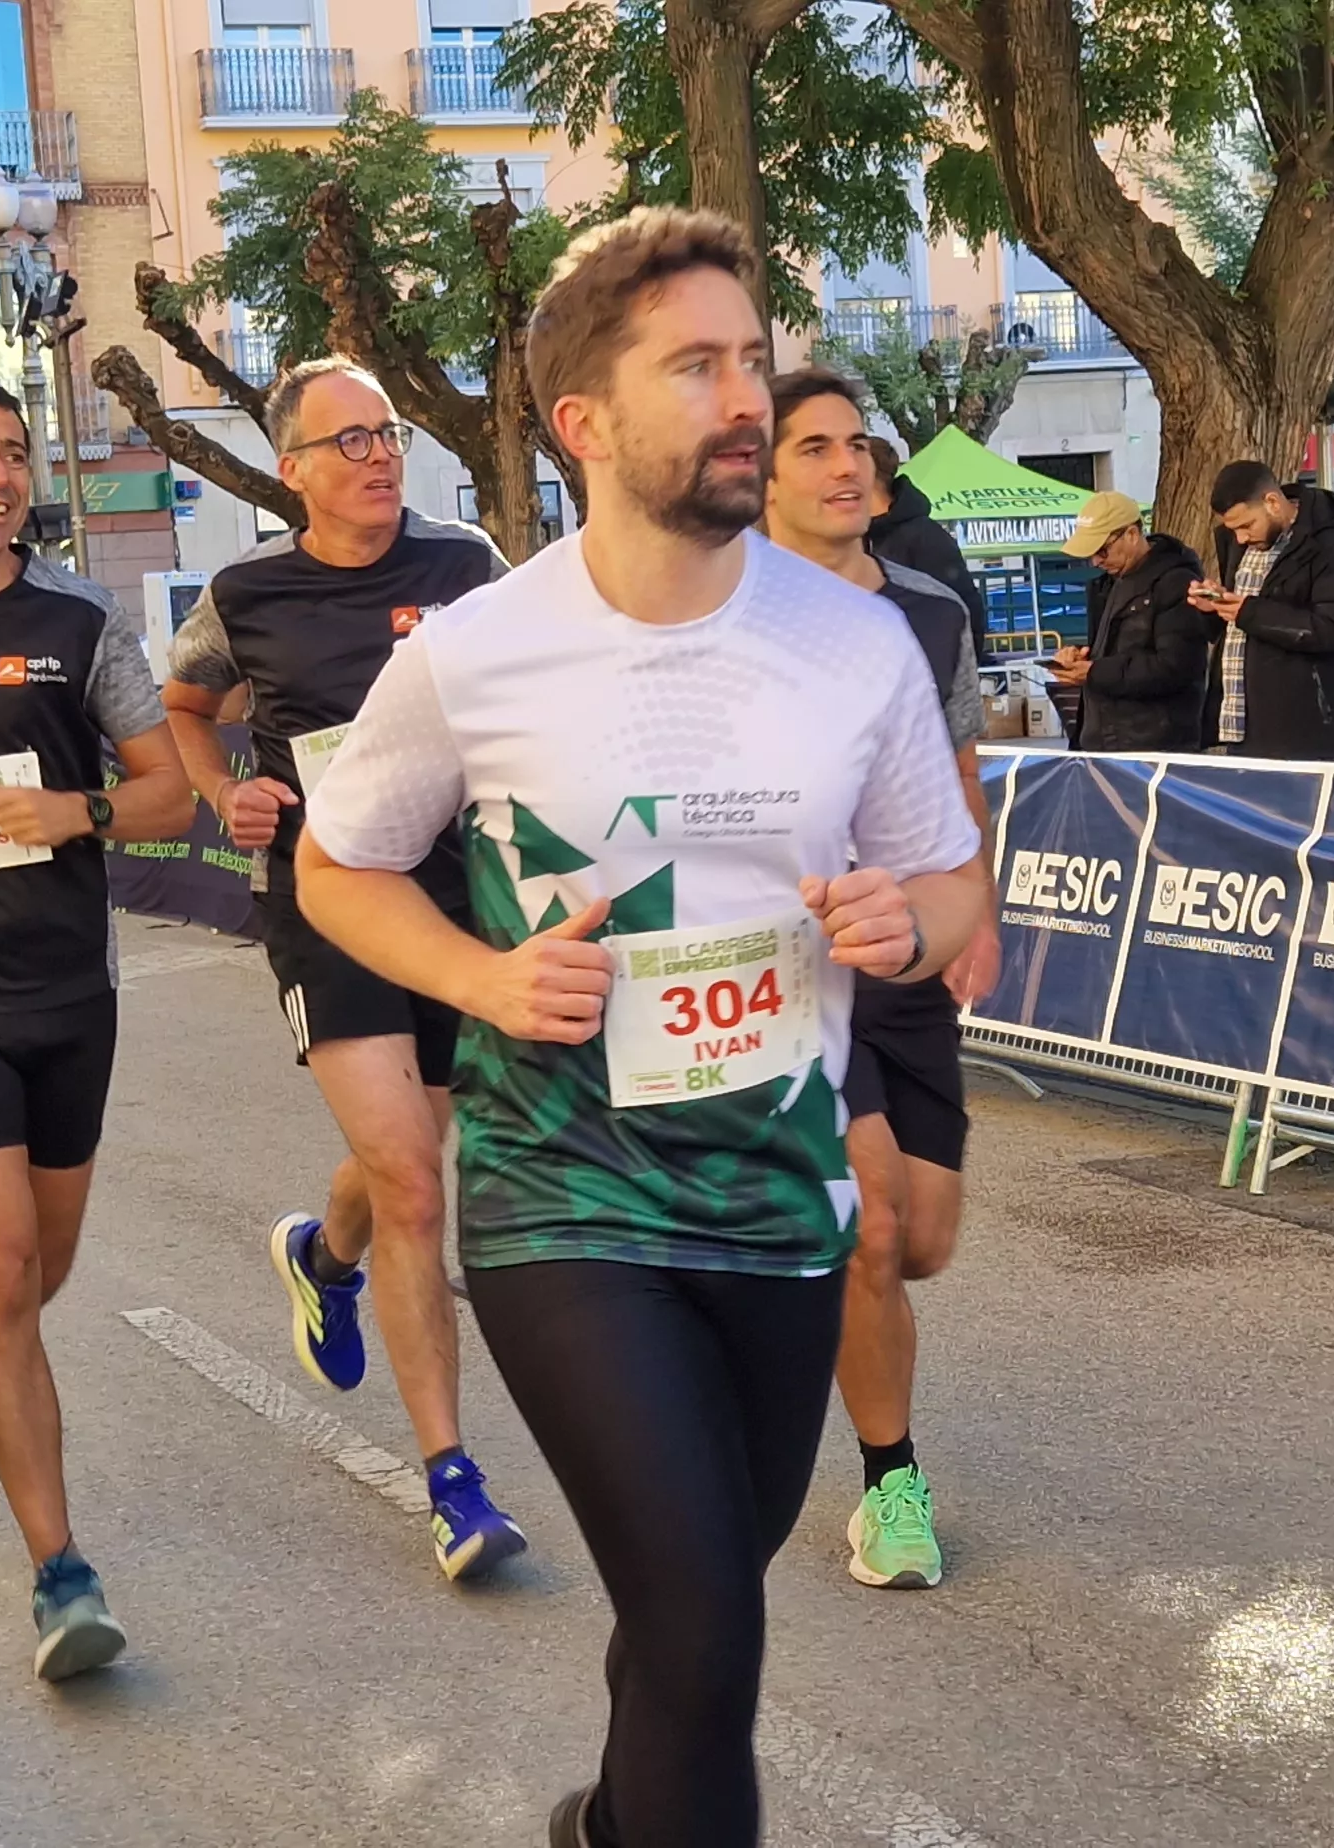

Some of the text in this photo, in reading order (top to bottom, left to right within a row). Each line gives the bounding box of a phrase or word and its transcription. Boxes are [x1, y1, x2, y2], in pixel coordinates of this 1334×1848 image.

[1061, 438, 1070, 452] 2
[960, 486, 1055, 499] FARTLECK
[976, 499, 1062, 509] SPORT
[967, 518, 1078, 545] AVITUALLAMIENT
[682, 808, 755, 824] técnica
[1033, 853, 1122, 917] ESIC
[1182, 867, 1287, 937] ESIC
[685, 928, 779, 958] CARRERA
[660, 967, 784, 1036] 304
[693, 1030, 764, 1063] IVAN
[686, 1063, 728, 1091] 8K
